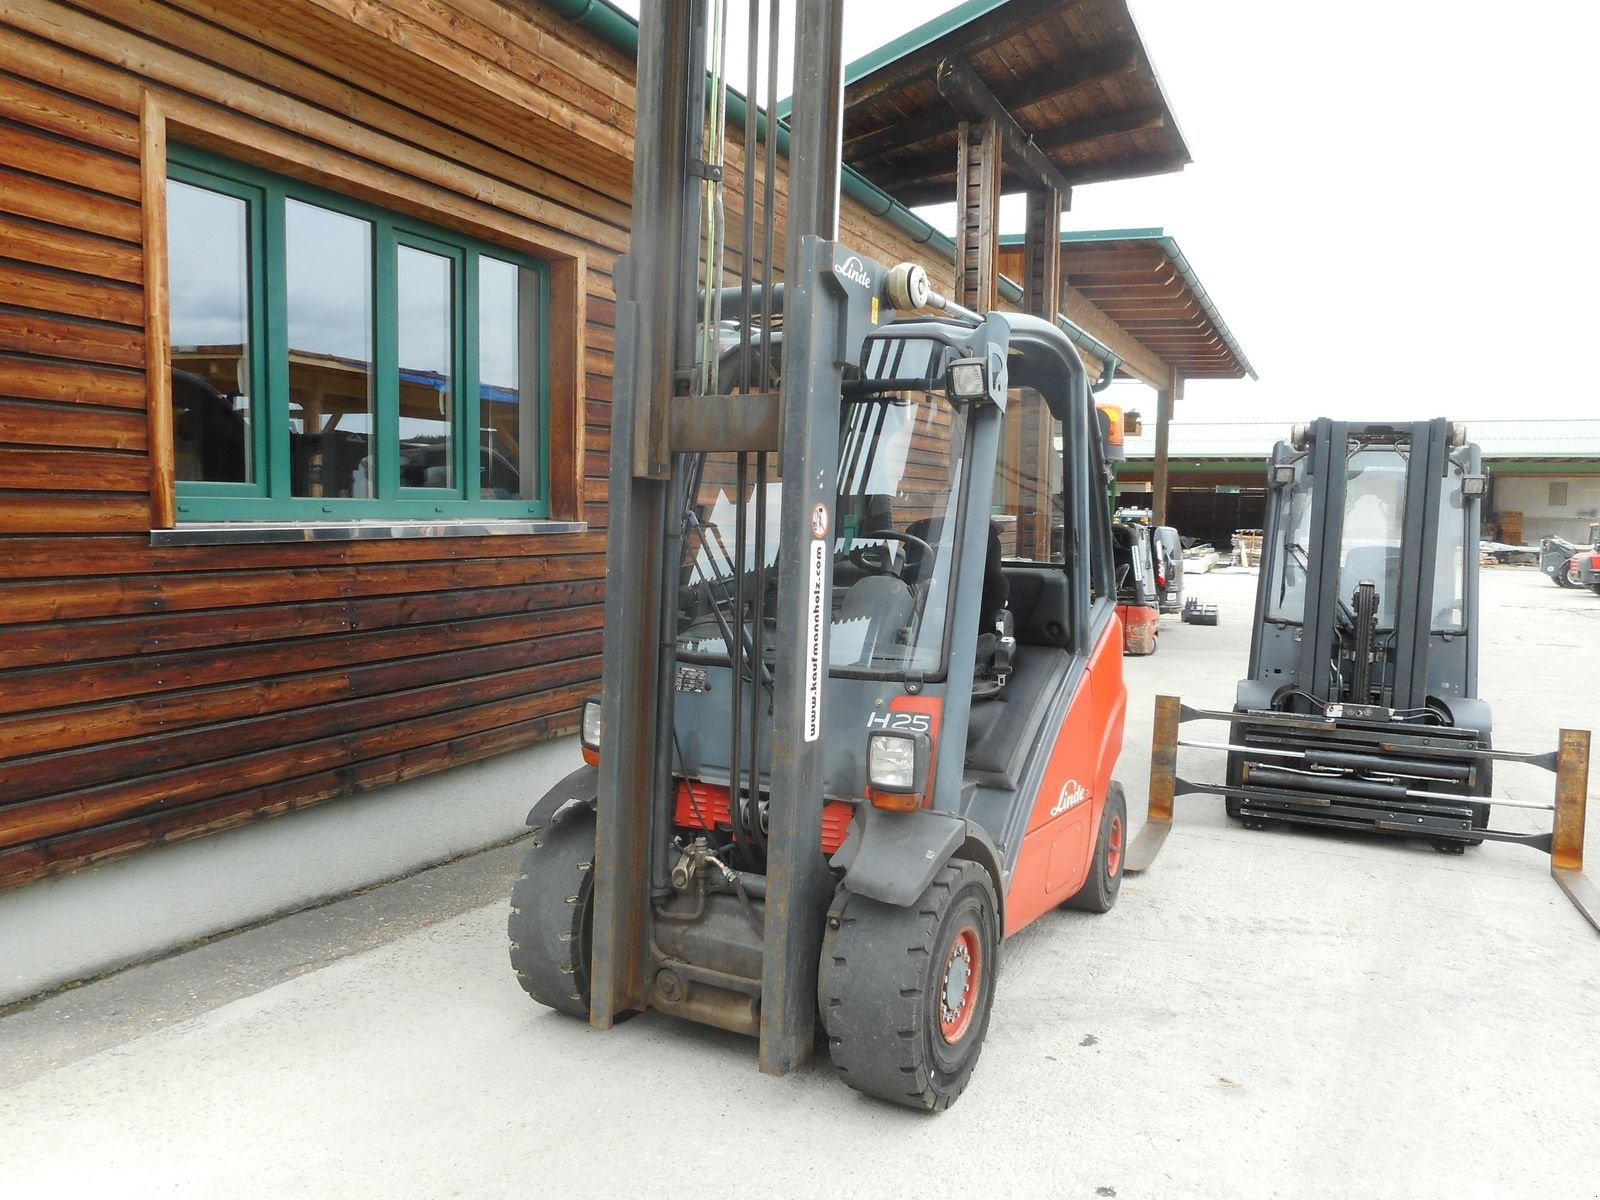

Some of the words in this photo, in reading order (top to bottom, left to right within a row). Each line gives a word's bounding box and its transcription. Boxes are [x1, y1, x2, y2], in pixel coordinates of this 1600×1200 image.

[834, 256, 871, 289] Linde
[810, 546, 822, 737] www.kaufmannholz.com
[1050, 779, 1085, 817] Linde
